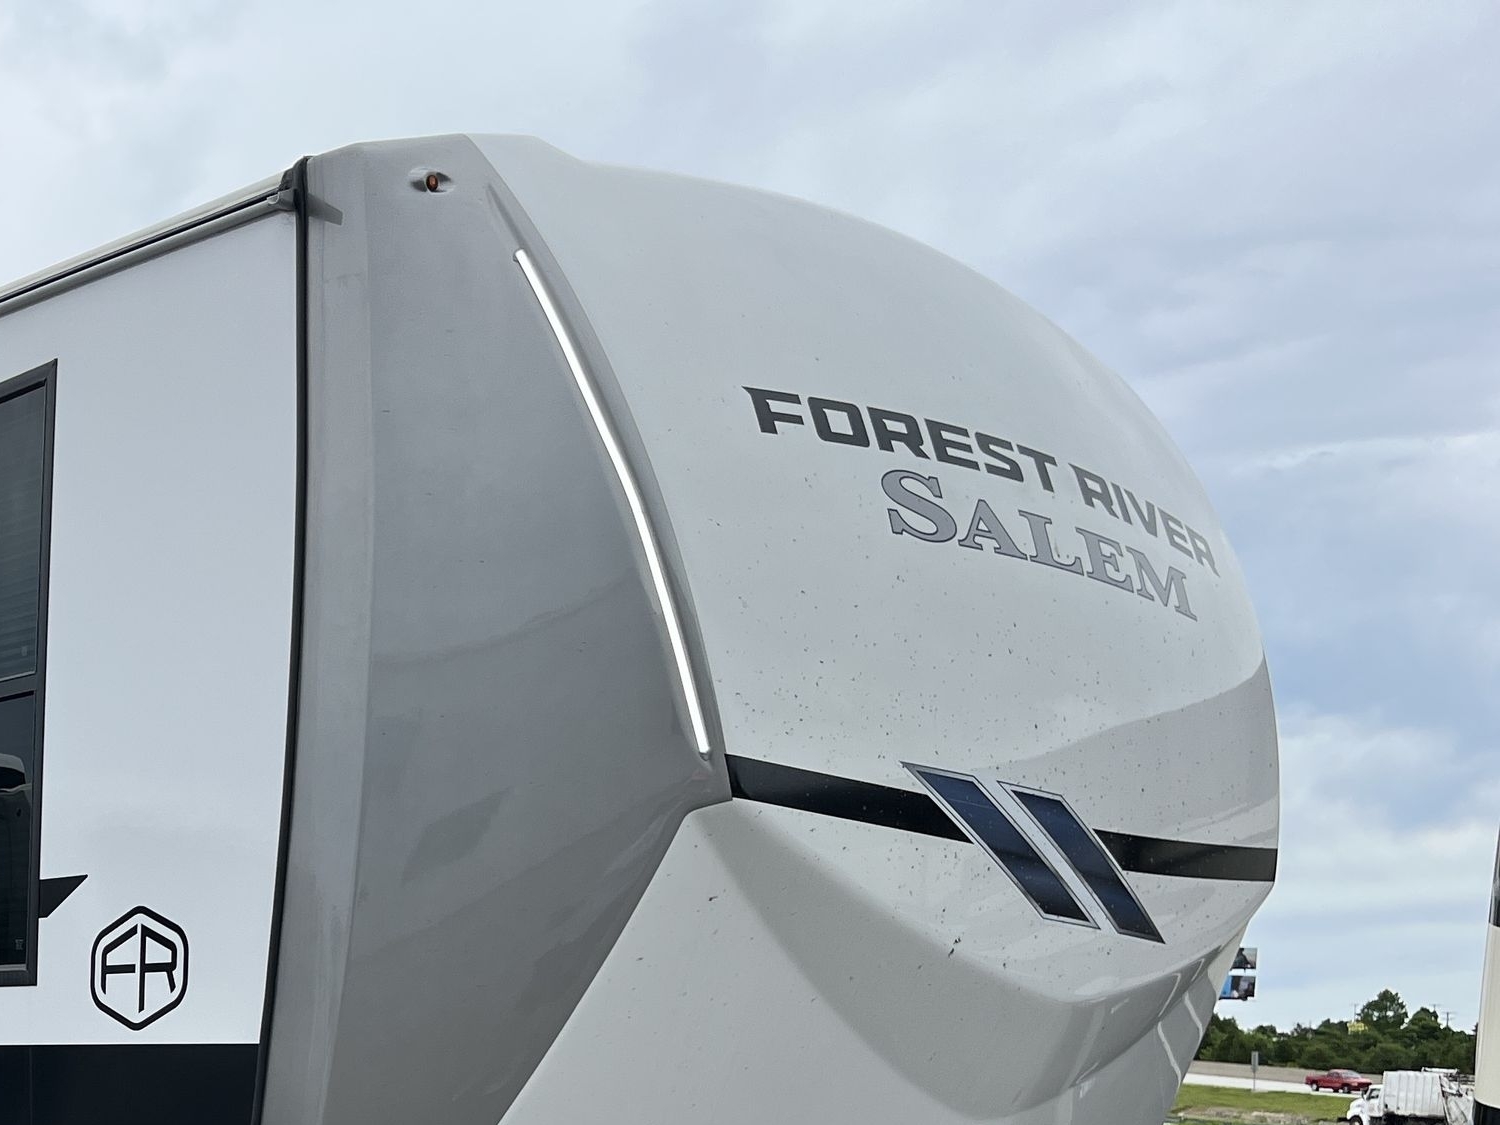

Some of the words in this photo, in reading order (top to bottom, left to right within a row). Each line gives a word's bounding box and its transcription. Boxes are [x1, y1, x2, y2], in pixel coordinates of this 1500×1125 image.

[741, 385, 1058, 493] FOREST
[1067, 462, 1221, 578] RIVER
[880, 468, 1199, 622] SALEM
